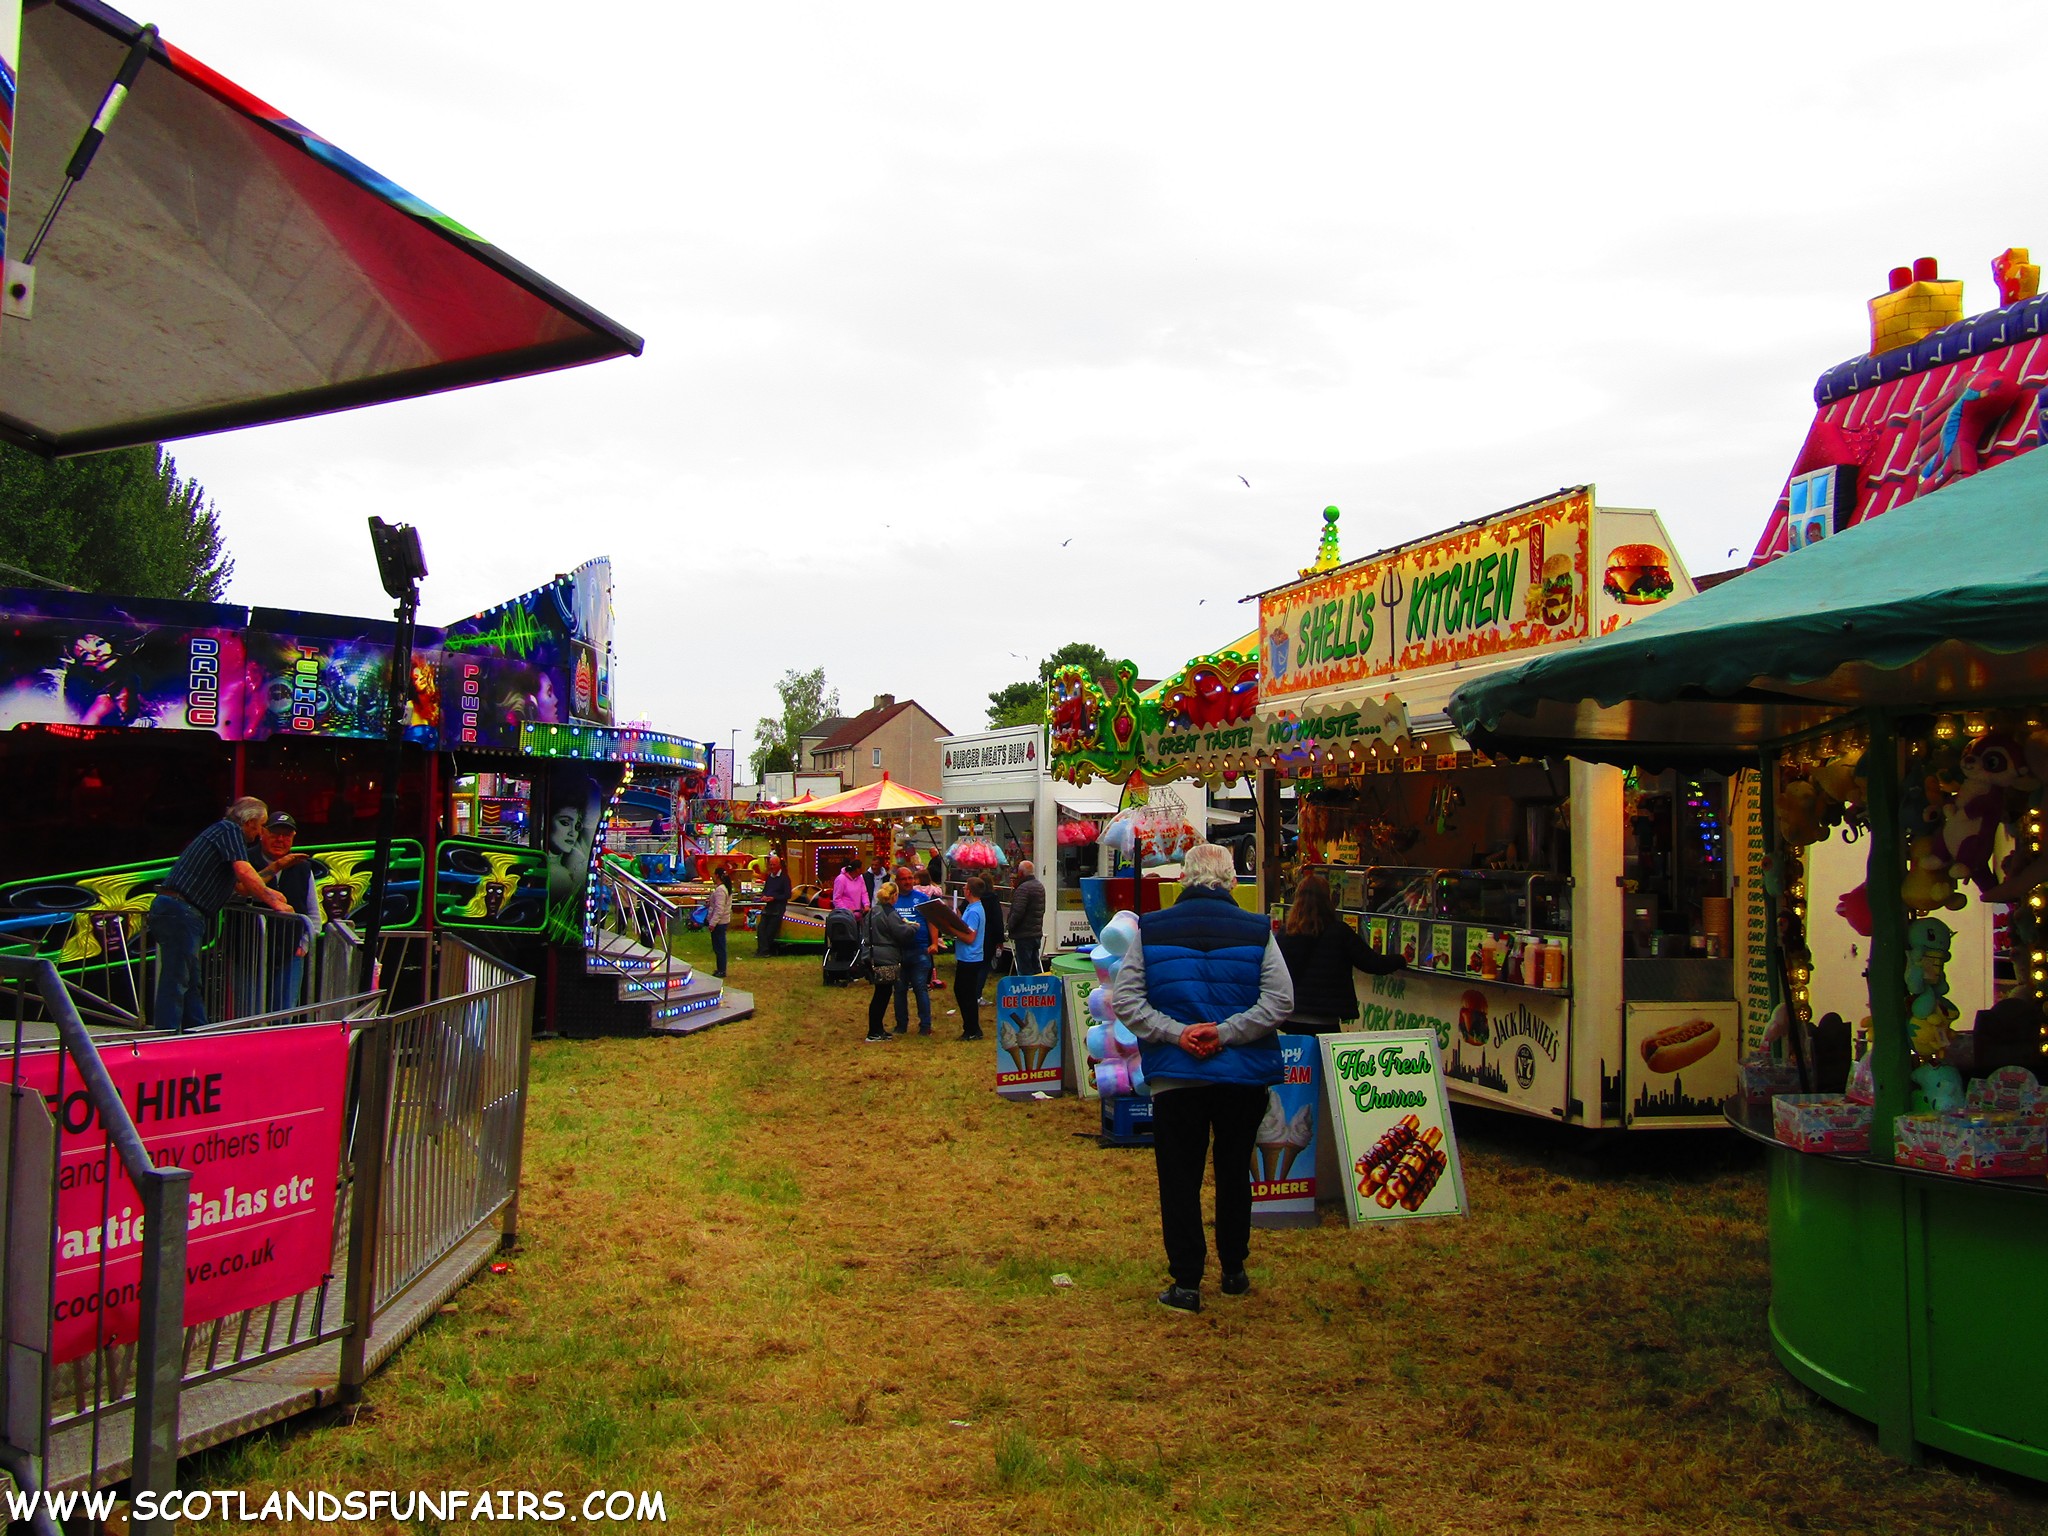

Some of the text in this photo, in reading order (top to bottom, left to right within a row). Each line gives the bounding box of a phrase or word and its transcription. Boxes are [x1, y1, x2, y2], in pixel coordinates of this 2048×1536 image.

[1297, 548, 1519, 669] SHELL'S KITCHEN
[188, 638, 218, 726] DANCE
[292, 646, 319, 731] TECHNO
[462, 664, 480, 743] POWER
[953, 743, 1025, 769] BURGER MEATS BUN
[1158, 734, 1201, 756] GREAT
[1204, 727, 1254, 751] TASTE!
[1267, 722, 1293, 744] NO
[1002, 995, 1057, 1008] ICE CREAM
[1008, 983, 1050, 995] Whippy
[1362, 1003, 1393, 1030] YORK
[1493, 1003, 1560, 1062] JACK DANIEL'S
[1002, 1070, 1057, 1083] SOLD HERE
[1337, 1047, 1431, 1080] Hot Fresh
[136, 1073, 223, 1123] HIRE
[1349, 1082, 1427, 1112] Churros
[192, 1132, 260, 1165] others
[267, 1121, 294, 1151] for
[273, 1175, 314, 1209] etc
[1271, 1182, 1309, 1196] HERE
